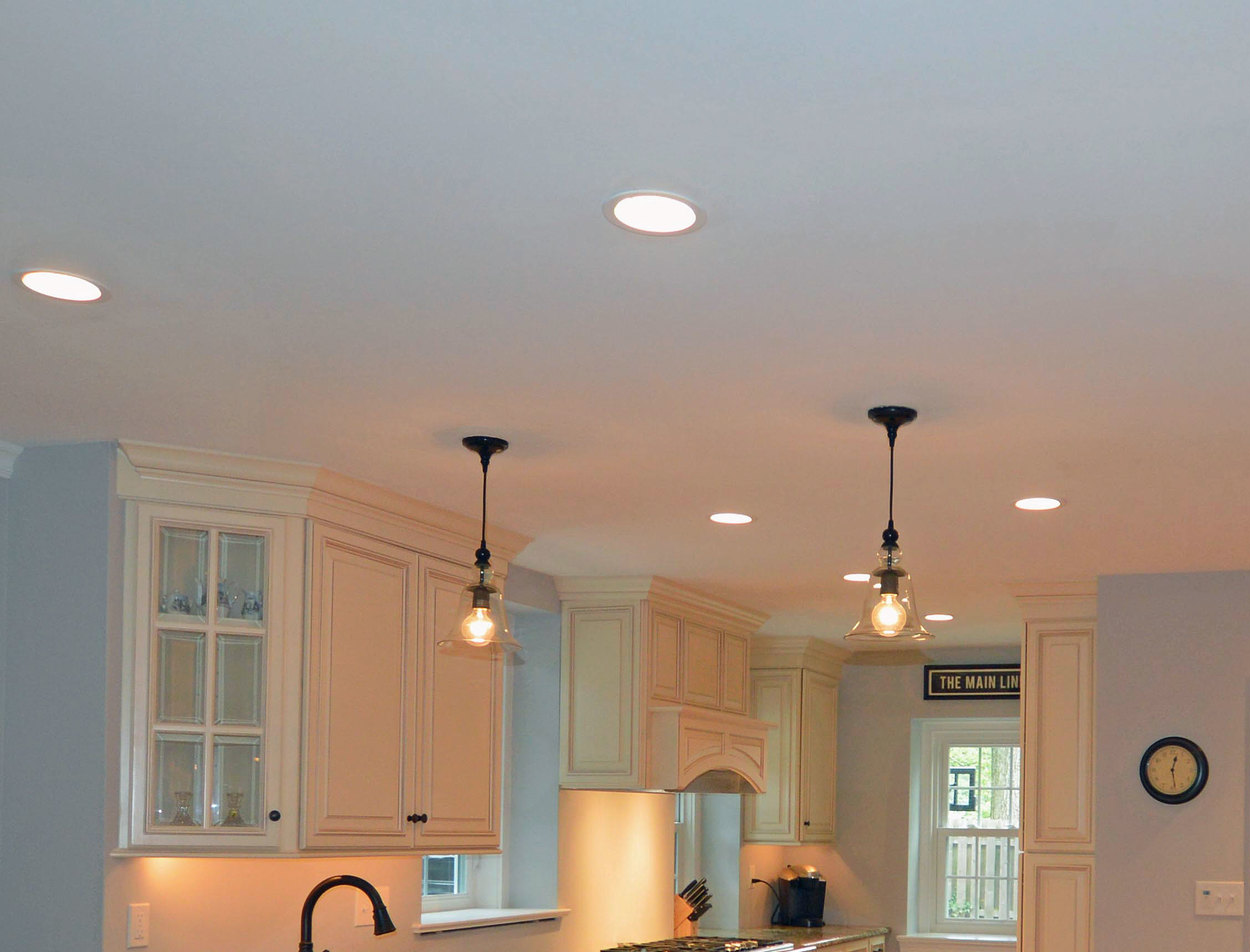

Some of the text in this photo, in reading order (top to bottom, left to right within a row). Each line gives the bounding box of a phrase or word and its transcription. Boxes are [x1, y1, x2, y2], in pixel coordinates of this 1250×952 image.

[940, 675, 1018, 689] THE MAIN LIN
